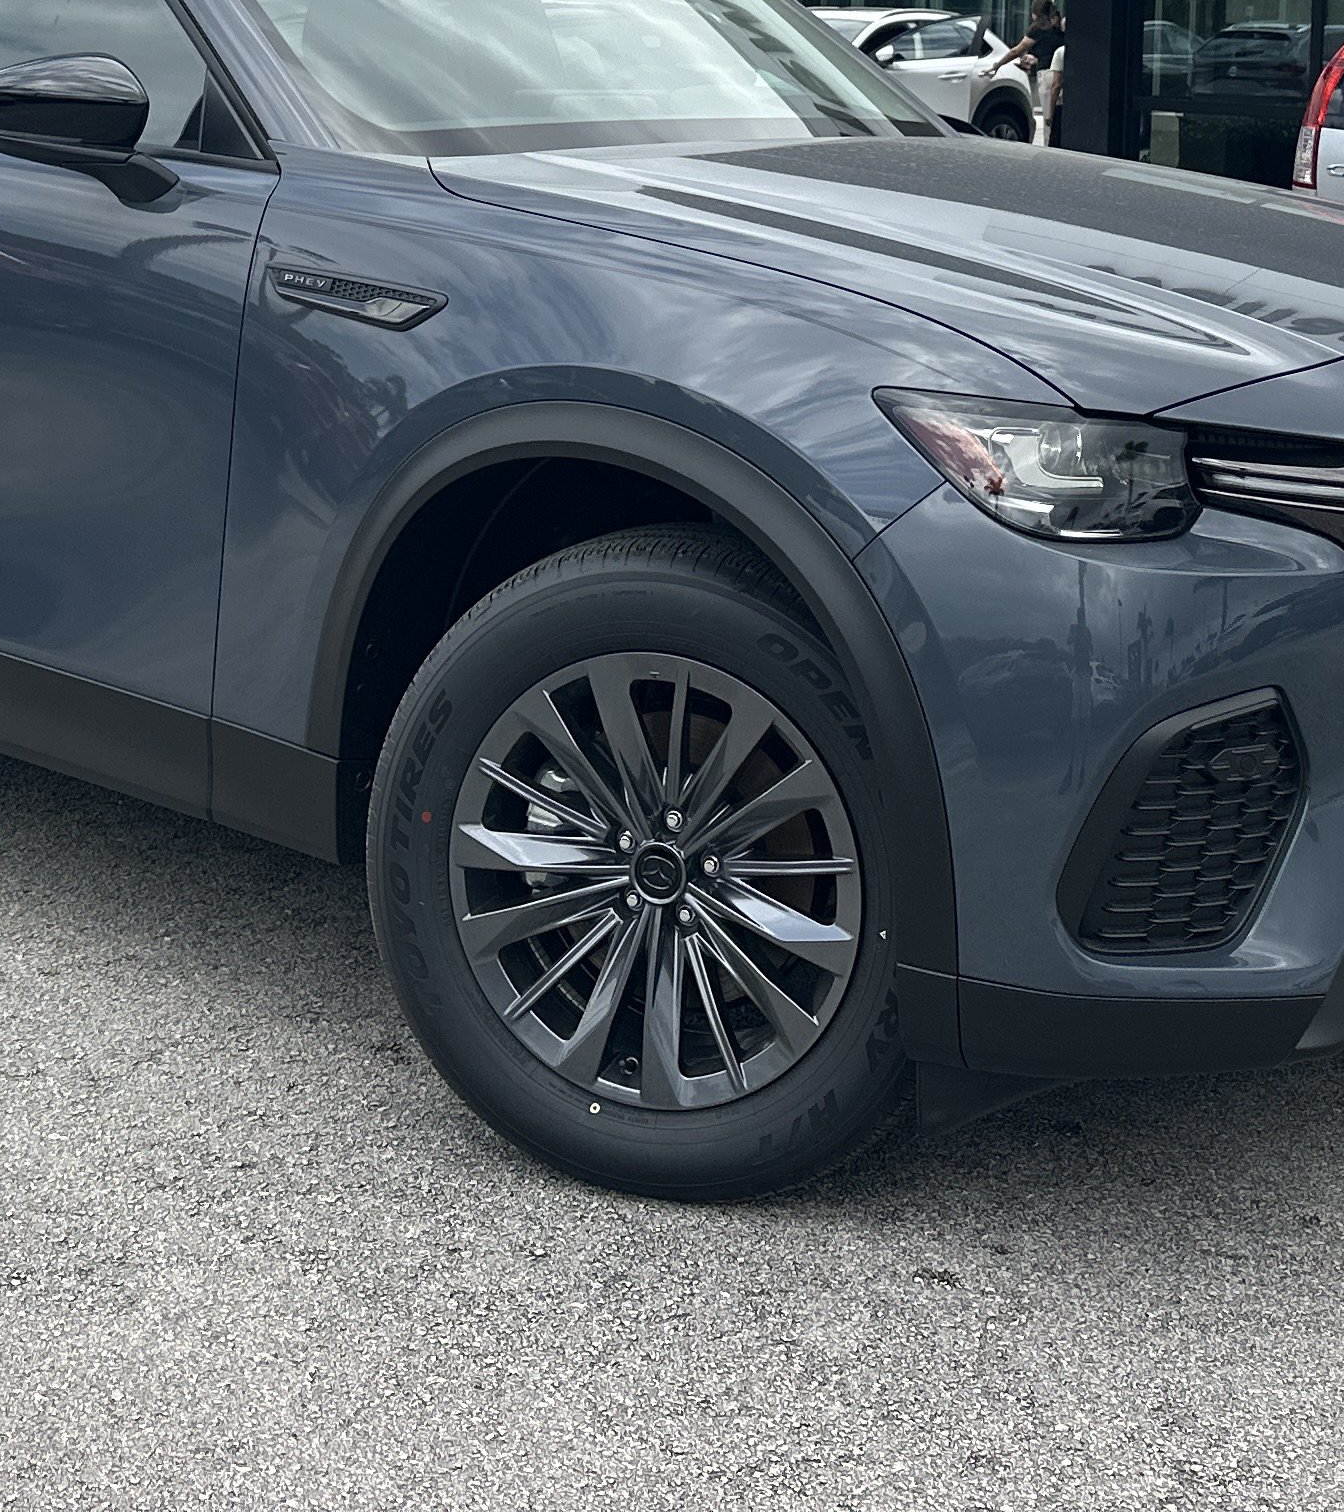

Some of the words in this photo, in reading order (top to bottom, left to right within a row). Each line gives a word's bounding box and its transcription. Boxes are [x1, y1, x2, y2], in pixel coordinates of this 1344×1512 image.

[284, 273, 326, 288] PHEV
[756, 633, 875, 761] OPEN
[390, 688, 454, 851] TIRES
